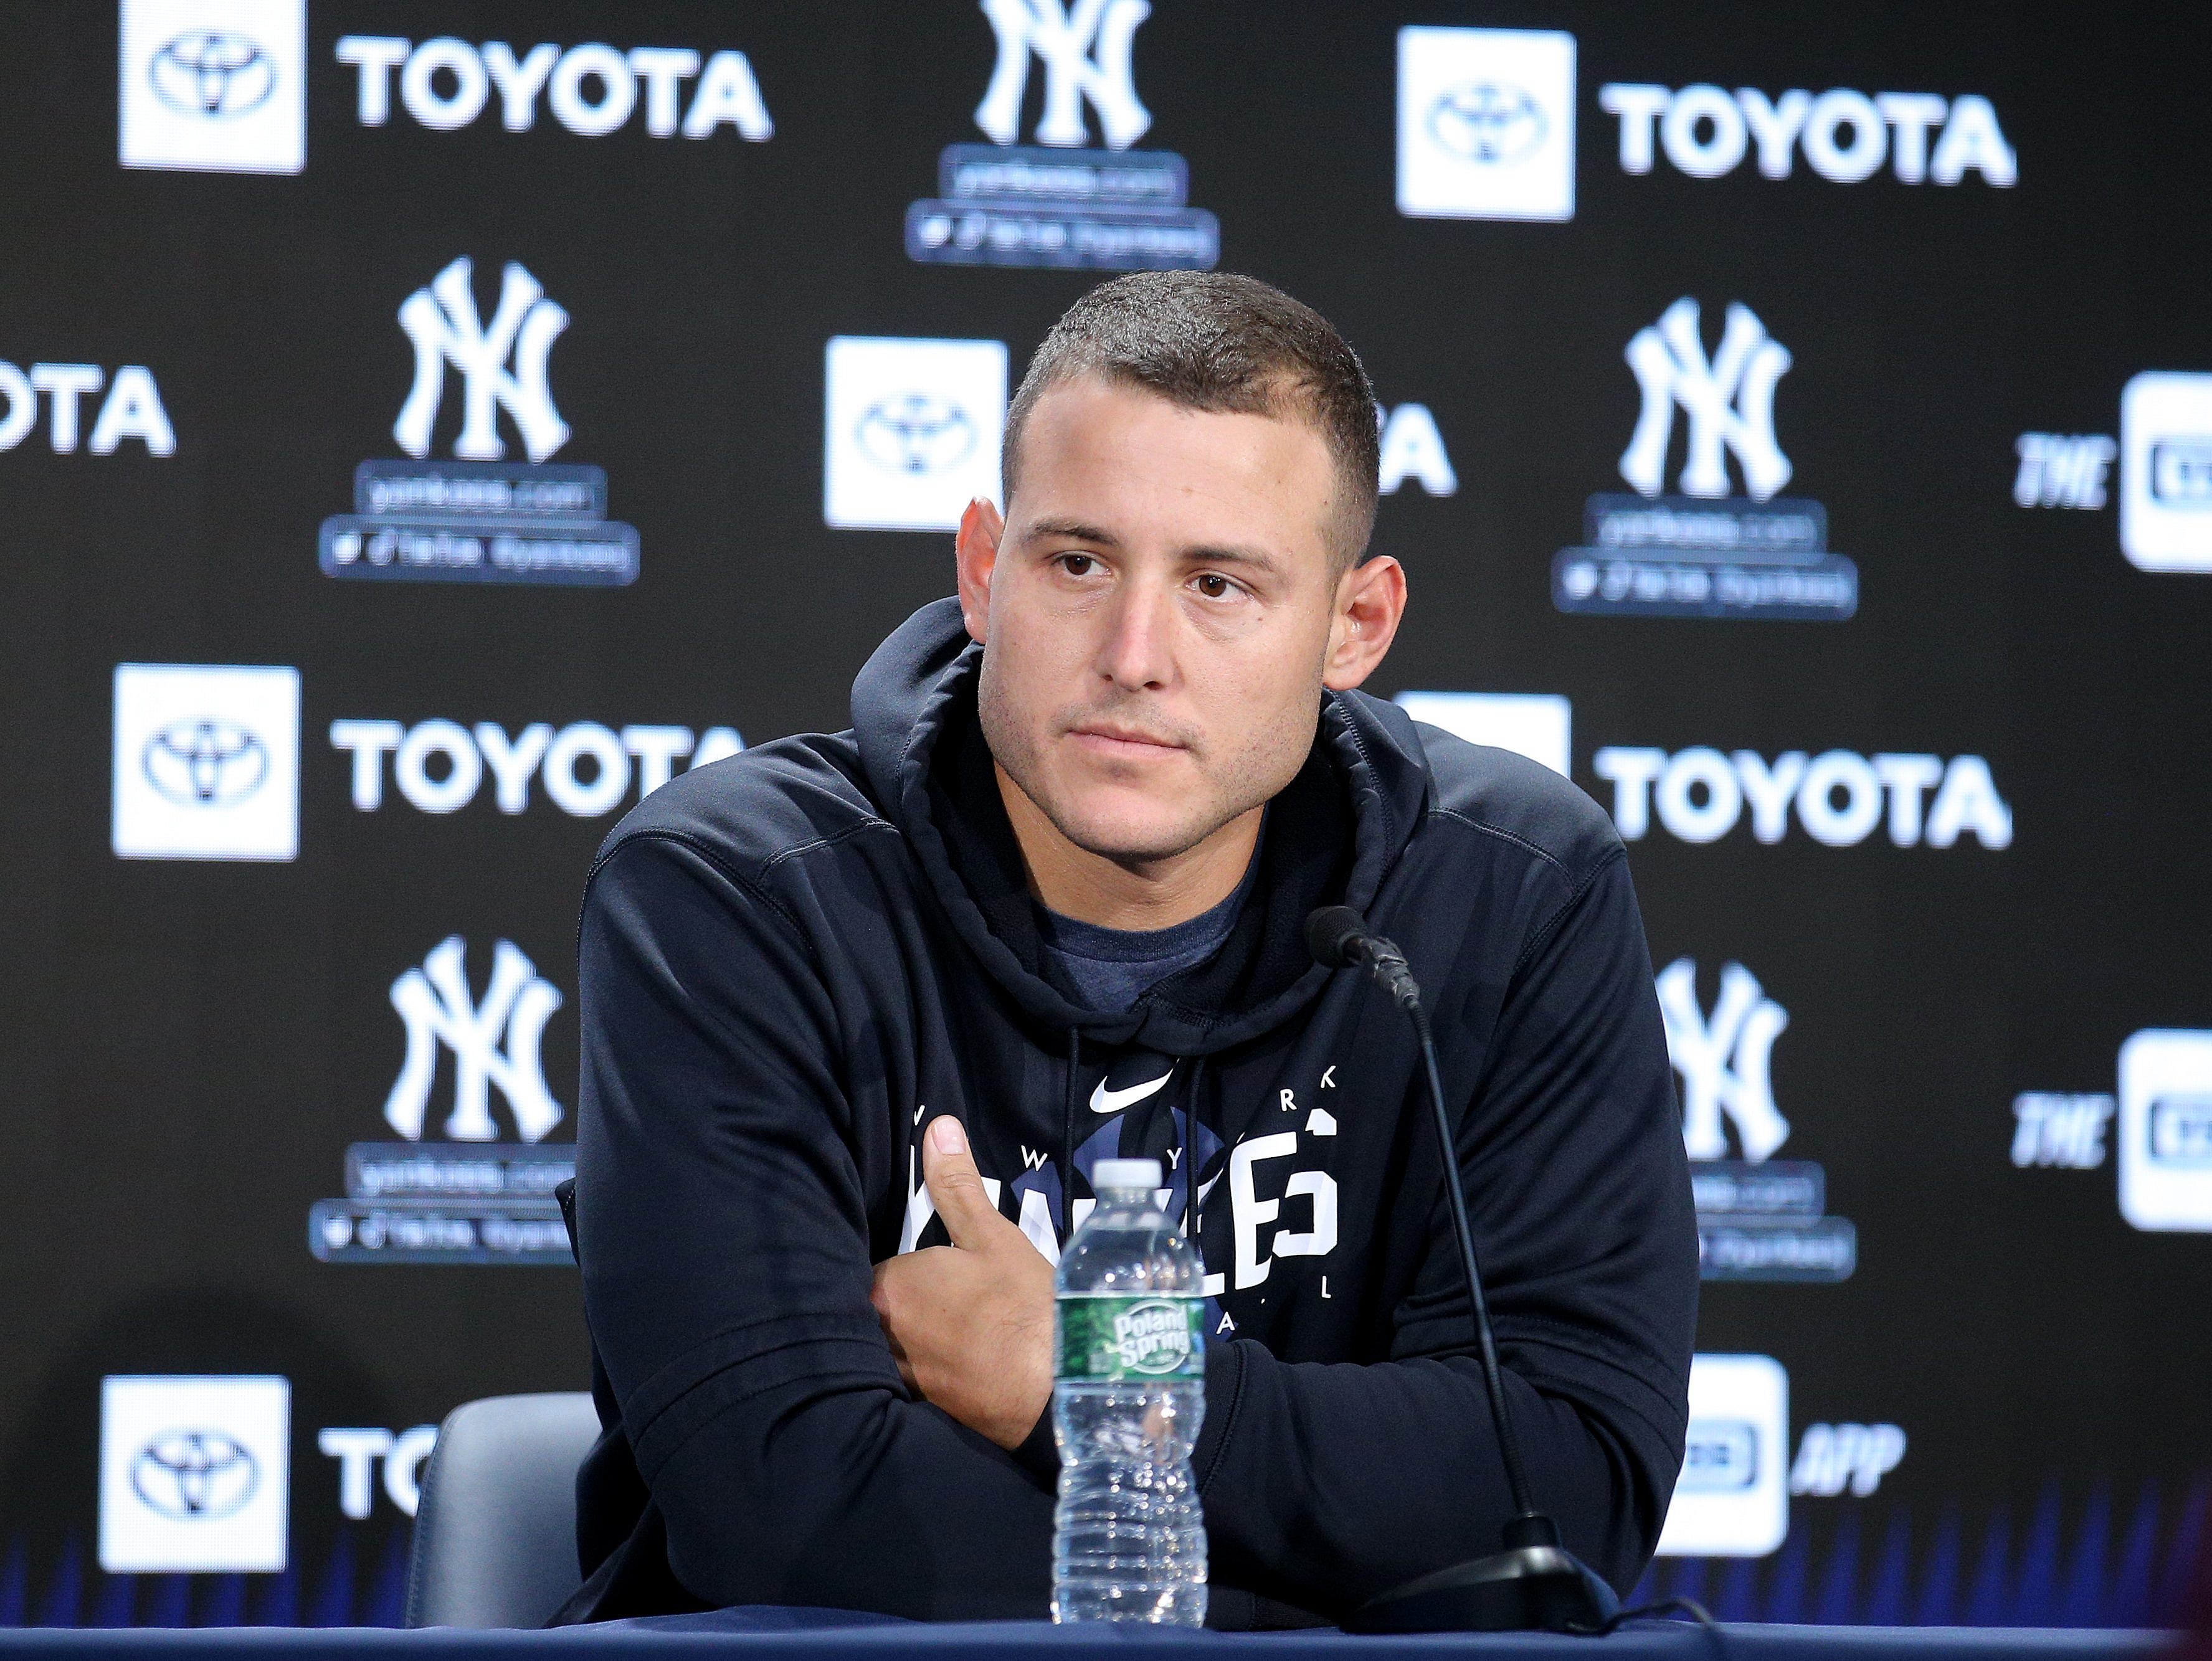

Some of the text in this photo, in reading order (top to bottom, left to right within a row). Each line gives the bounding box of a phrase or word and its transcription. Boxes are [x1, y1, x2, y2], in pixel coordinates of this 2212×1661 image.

[335, 35, 773, 142] TOYOTA
[1598, 82, 2018, 187] TOYOTA
[393, 255, 571, 465] NY
[1620, 296, 1793, 503] NY
[2014, 433, 2116, 511] THE
[329, 718, 744, 816] TOYOT
[1594, 746, 2013, 849] TOYOTA
[384, 935, 564, 1143] NY
[2011, 1092, 2115, 1170] THE
[1114, 1304, 1187, 1343] Poland
[1121, 1329, 1191, 1368] Spring
[1789, 1422, 1907, 1498] APP
